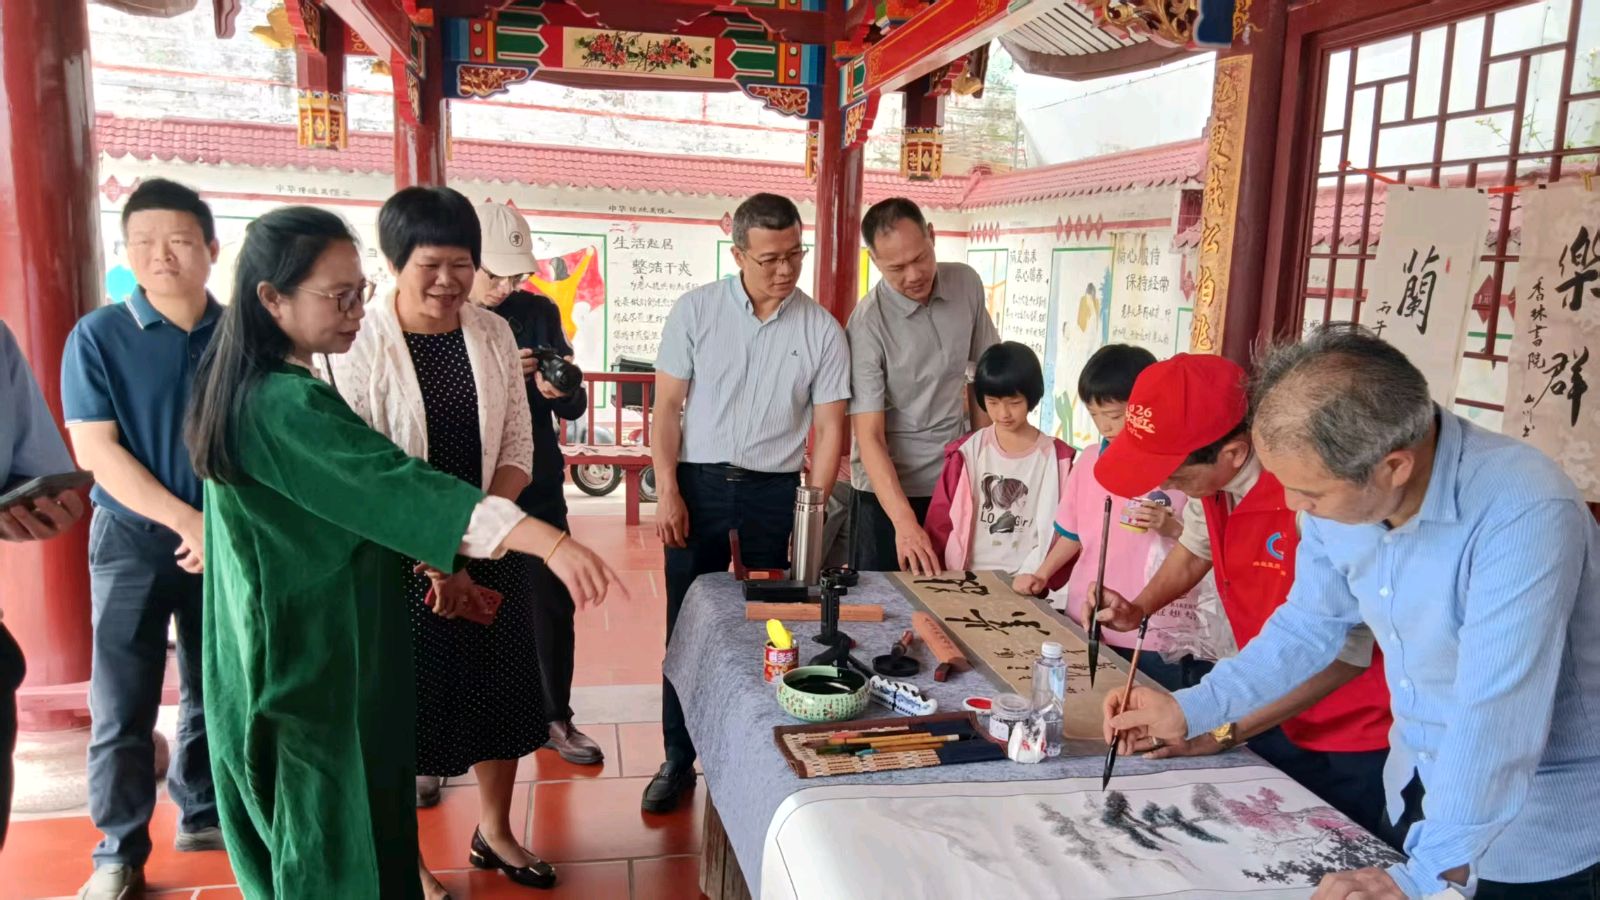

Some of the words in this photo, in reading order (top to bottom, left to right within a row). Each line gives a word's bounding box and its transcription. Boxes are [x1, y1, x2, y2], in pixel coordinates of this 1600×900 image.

[612, 235, 674, 250] 生活起居
[1126, 274, 1170, 293] 保持经常
[1396, 245, 1440, 335] 蘭
